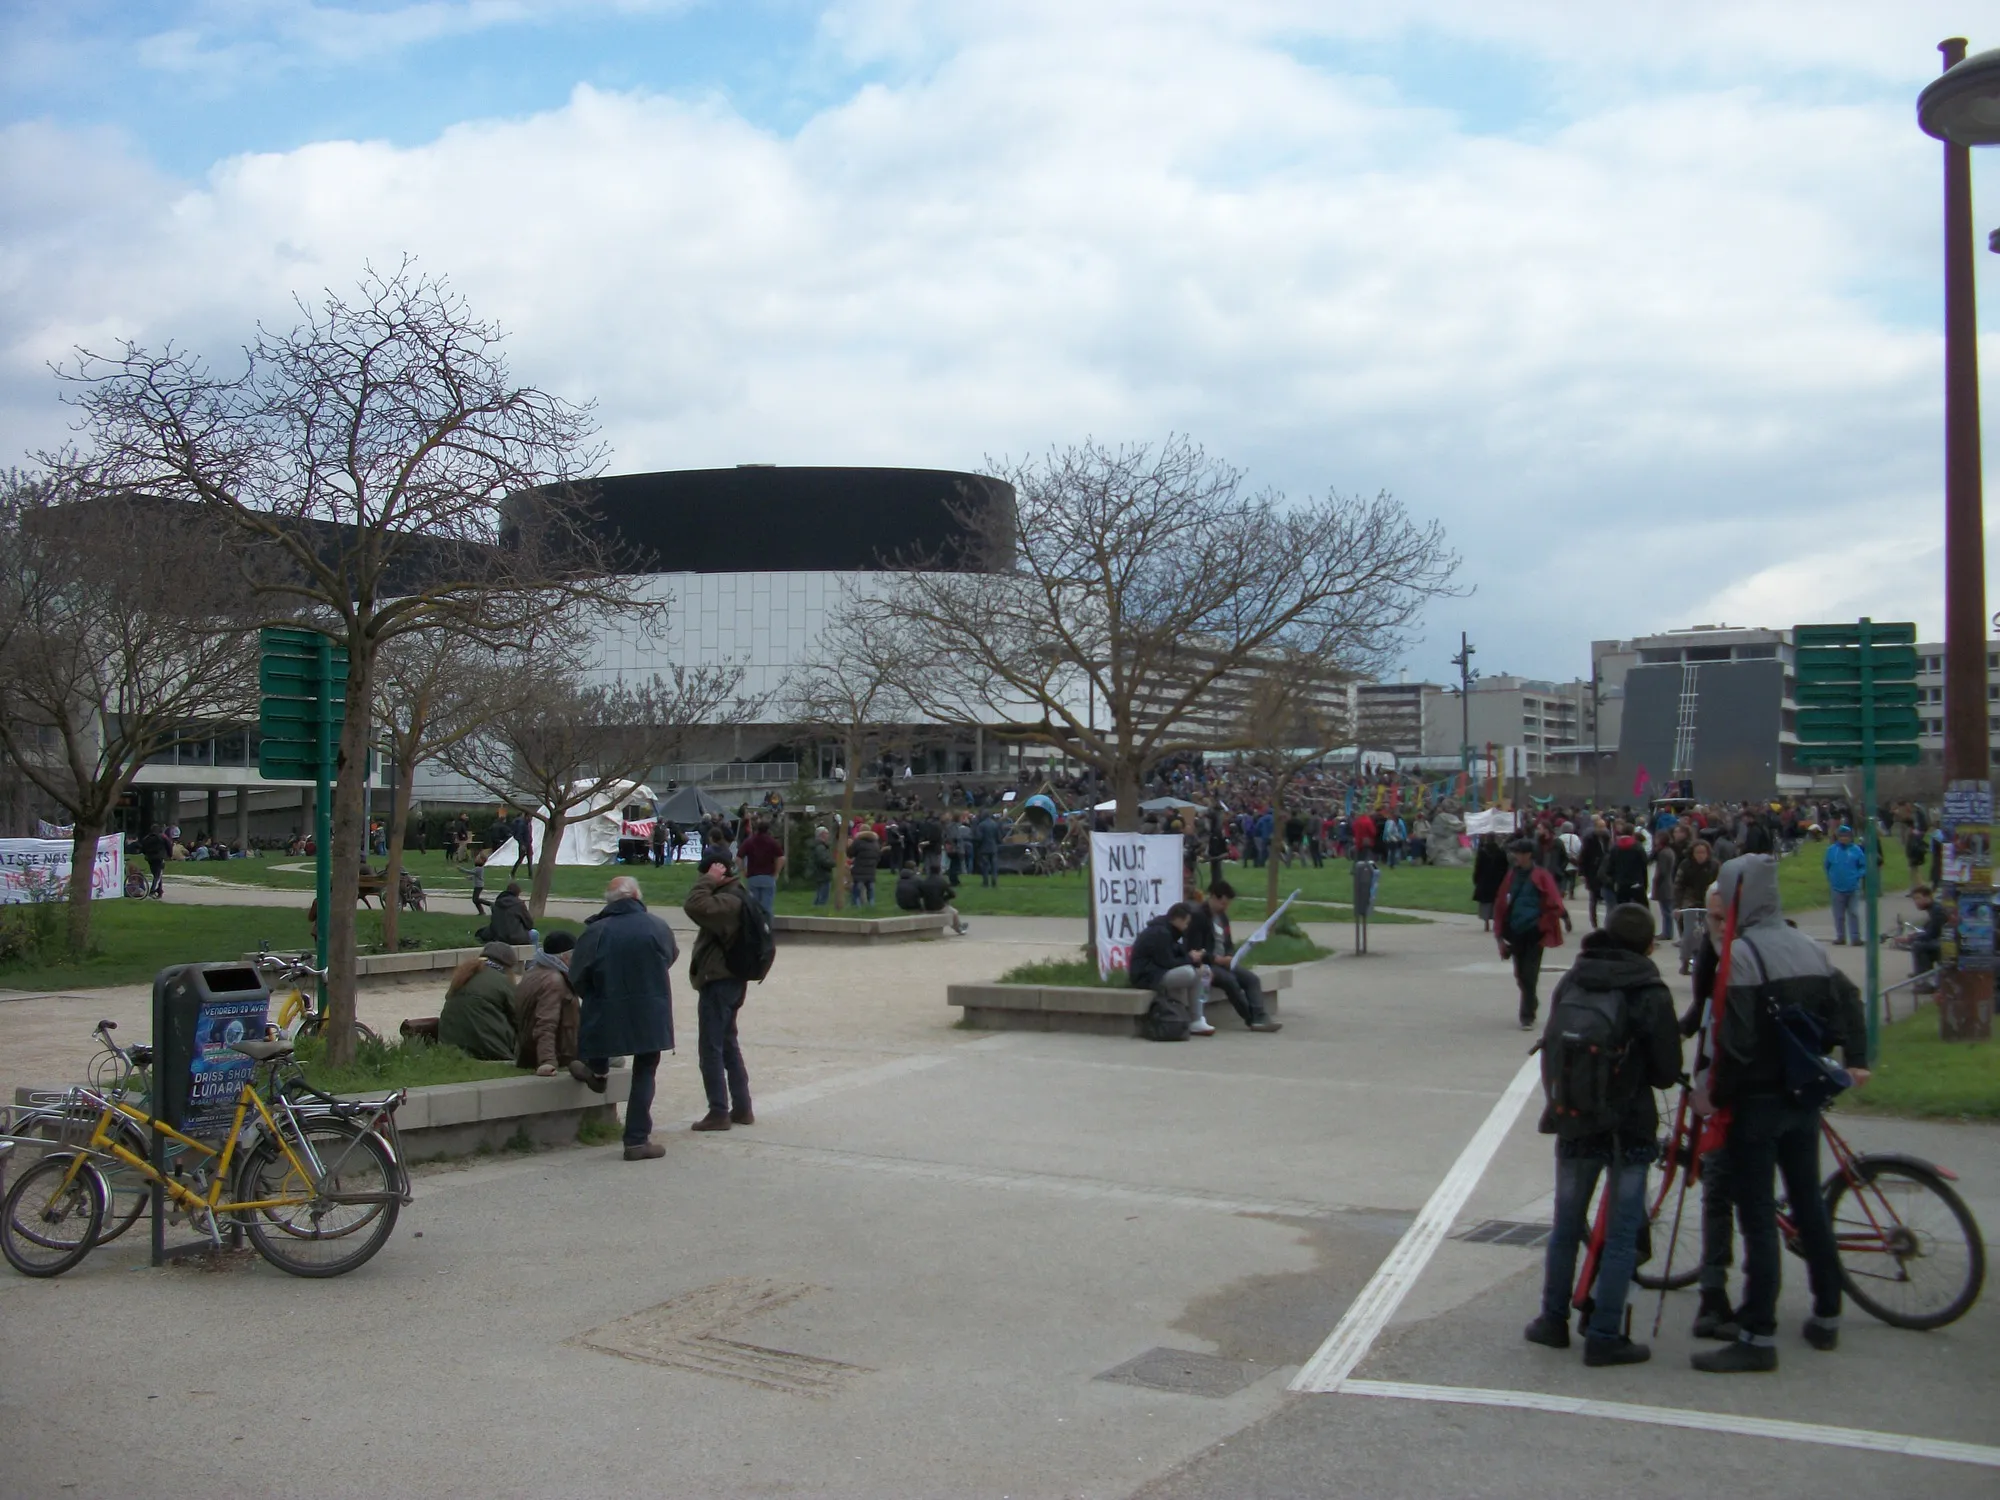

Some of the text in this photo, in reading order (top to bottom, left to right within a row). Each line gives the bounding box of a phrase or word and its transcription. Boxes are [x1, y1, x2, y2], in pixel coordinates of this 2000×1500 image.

[44, 853, 68, 864] NOS
[1109, 845, 1145, 872] NUT
[204, 1005, 239, 1016] VENDREDI
[195, 1072, 224, 1083] DRISS
